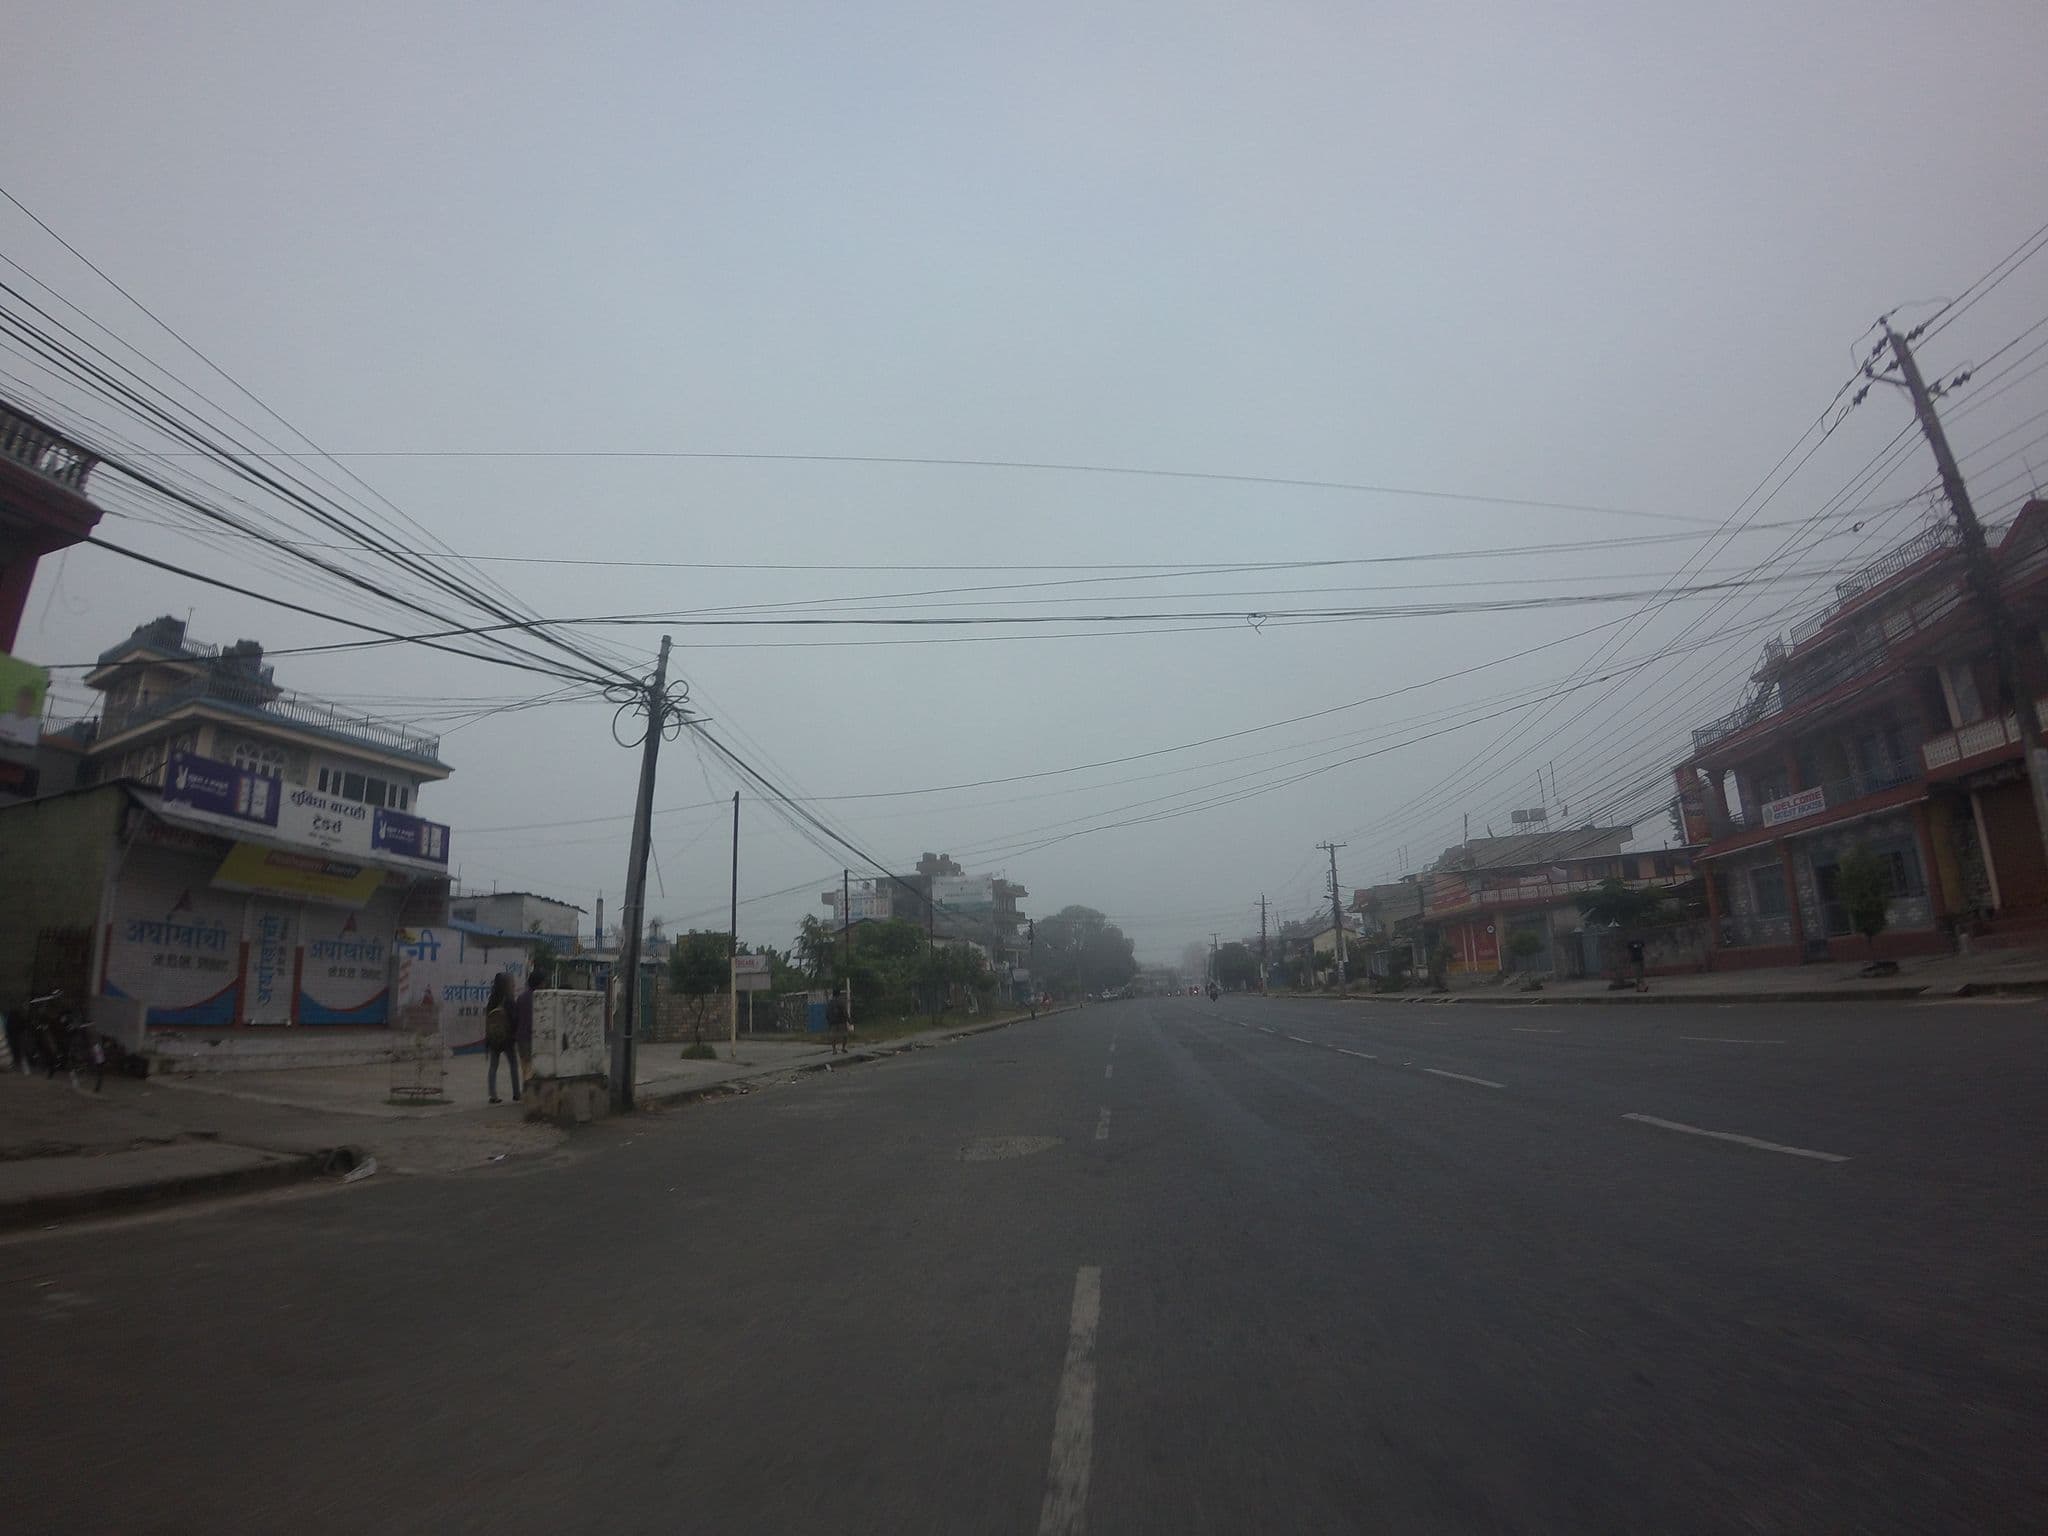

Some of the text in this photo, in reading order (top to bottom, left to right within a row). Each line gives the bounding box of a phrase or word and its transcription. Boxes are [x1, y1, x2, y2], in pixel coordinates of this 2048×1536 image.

[1774, 792, 1822, 812] WELCOME
[1774, 799, 1824, 820] GUEST HOUSE
